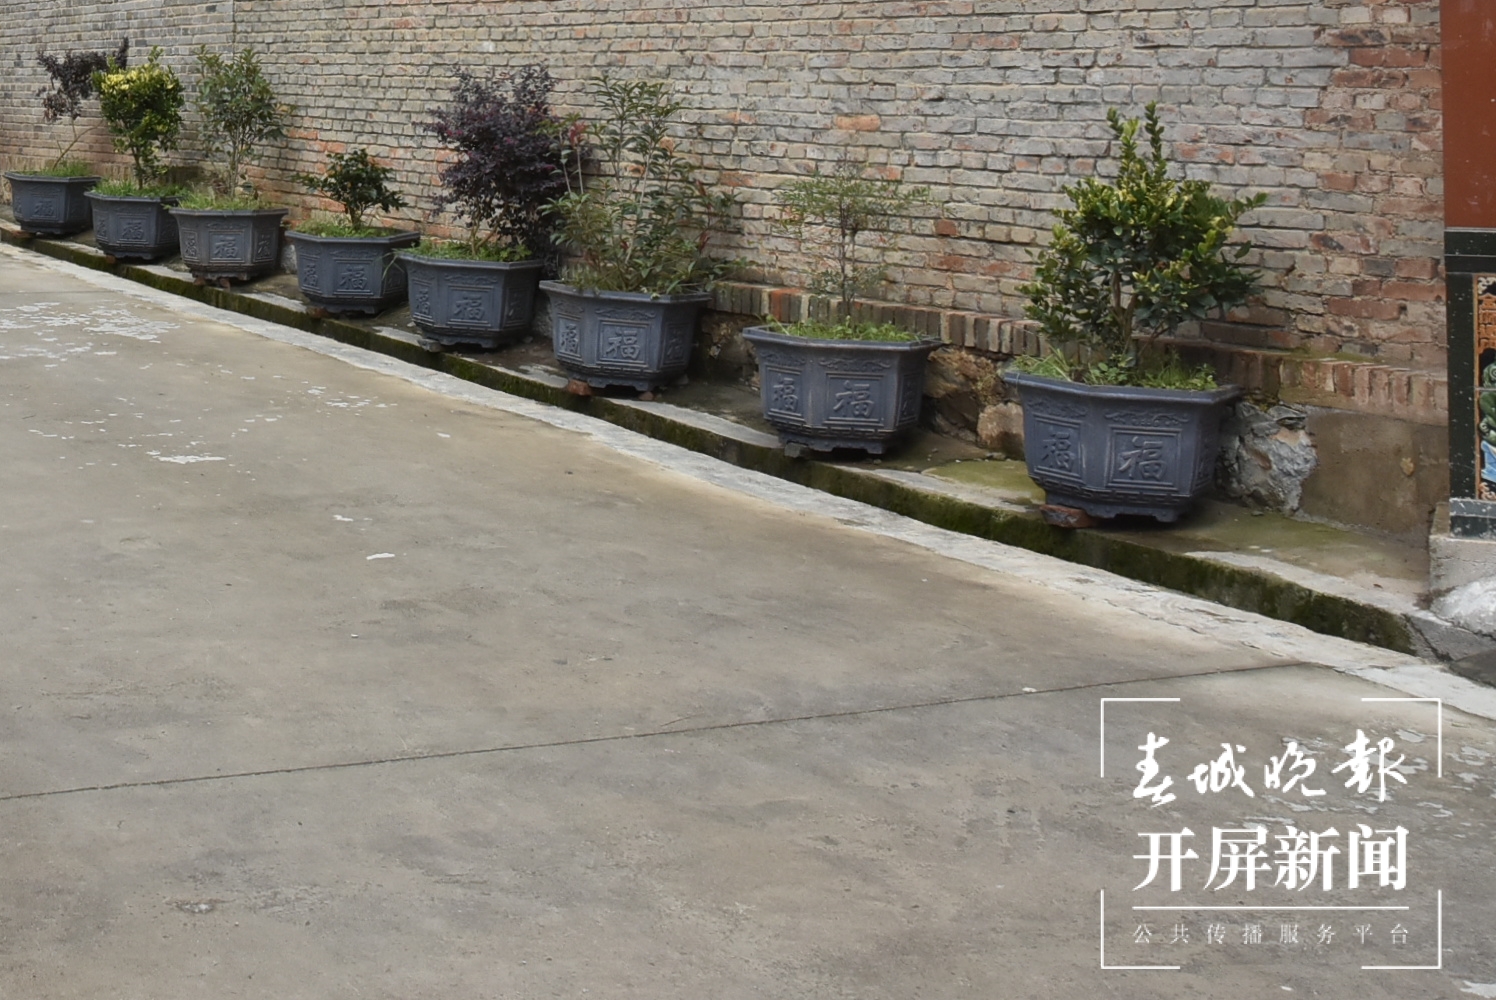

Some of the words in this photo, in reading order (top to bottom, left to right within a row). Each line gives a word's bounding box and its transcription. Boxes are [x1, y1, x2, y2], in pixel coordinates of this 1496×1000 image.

[213, 233, 240, 259] 福
[339, 264, 369, 291] 福
[453, 295, 486, 321] 福
[604, 327, 642, 360] 福
[773, 373, 799, 411] 福
[831, 379, 875, 417] 福
[1042, 426, 1077, 472] 福
[1117, 435, 1168, 481] 福
